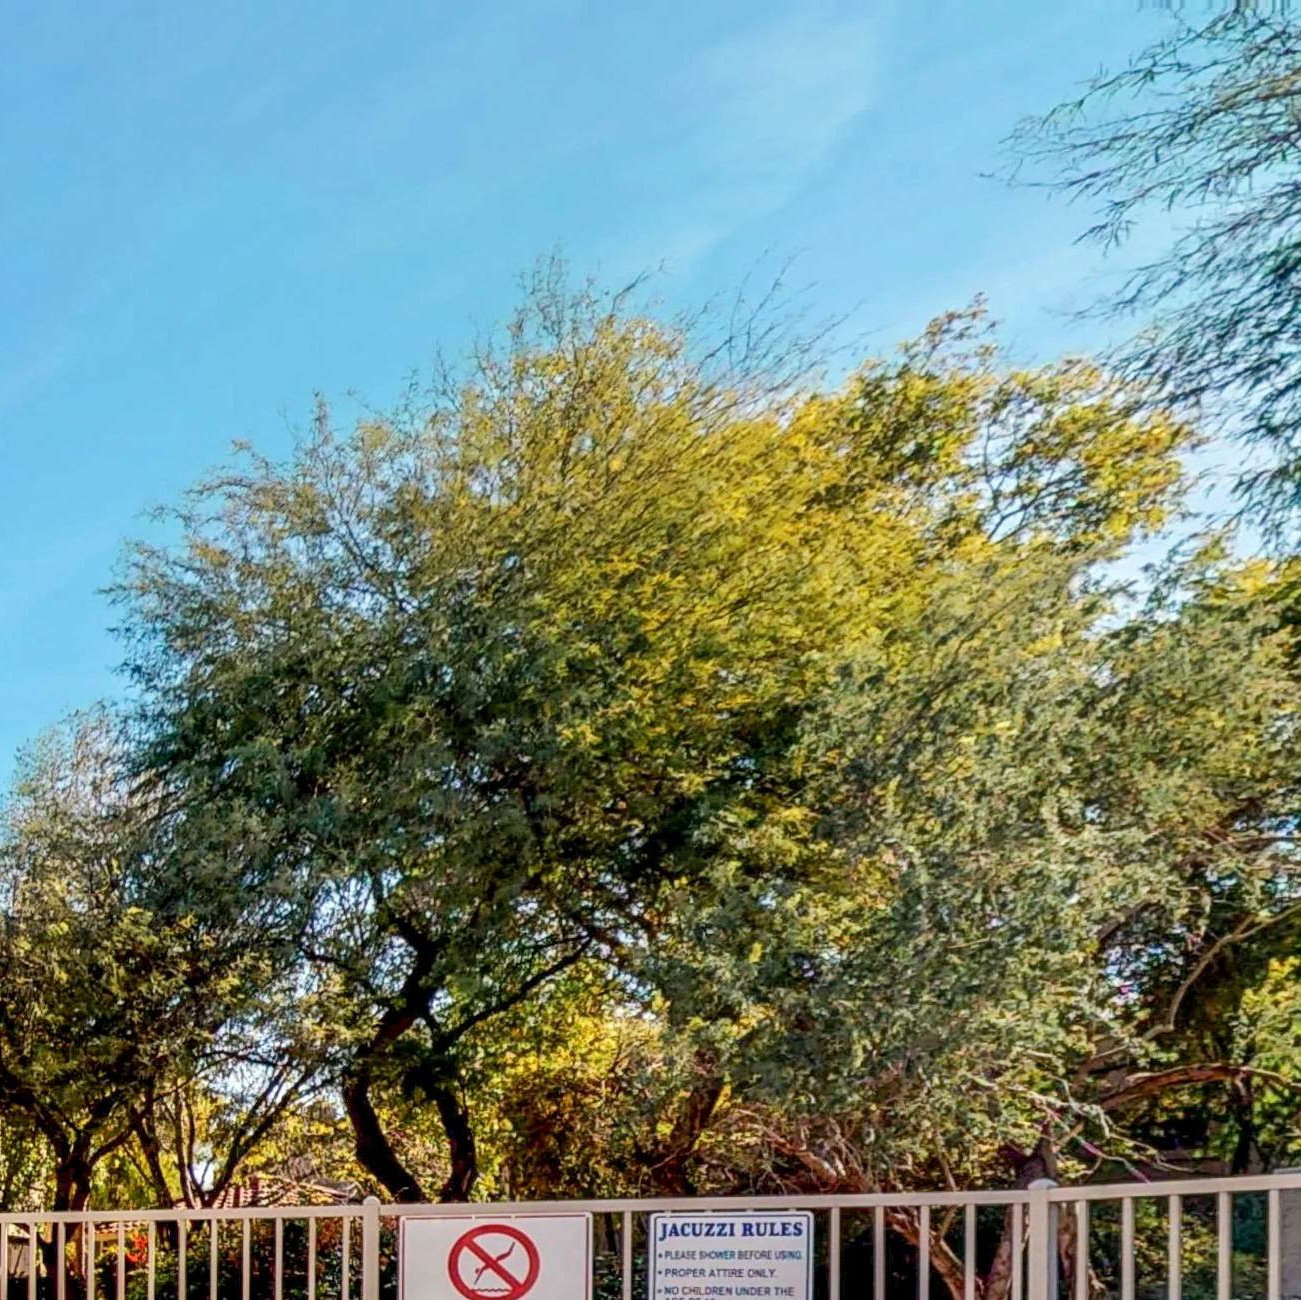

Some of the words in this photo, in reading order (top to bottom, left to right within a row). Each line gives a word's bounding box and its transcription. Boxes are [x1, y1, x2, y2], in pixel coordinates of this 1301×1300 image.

[659, 1223, 735, 1241] JACUZZI
[741, 1222, 803, 1237] RULES
[664, 1251, 696, 1260] PLEASE
[699, 1251, 736, 1260] SHOWER
[738, 1251, 772, 1260] BEFORE
[665, 1269, 705, 1277] PROPER
[708, 1269, 744, 1277] ATTIRE
[664, 1287, 679, 1295] NO
[682, 1287, 732, 1296] CHILDREN
[735, 1287, 771, 1296] UNDER
[774, 1287, 794, 1296] THE
